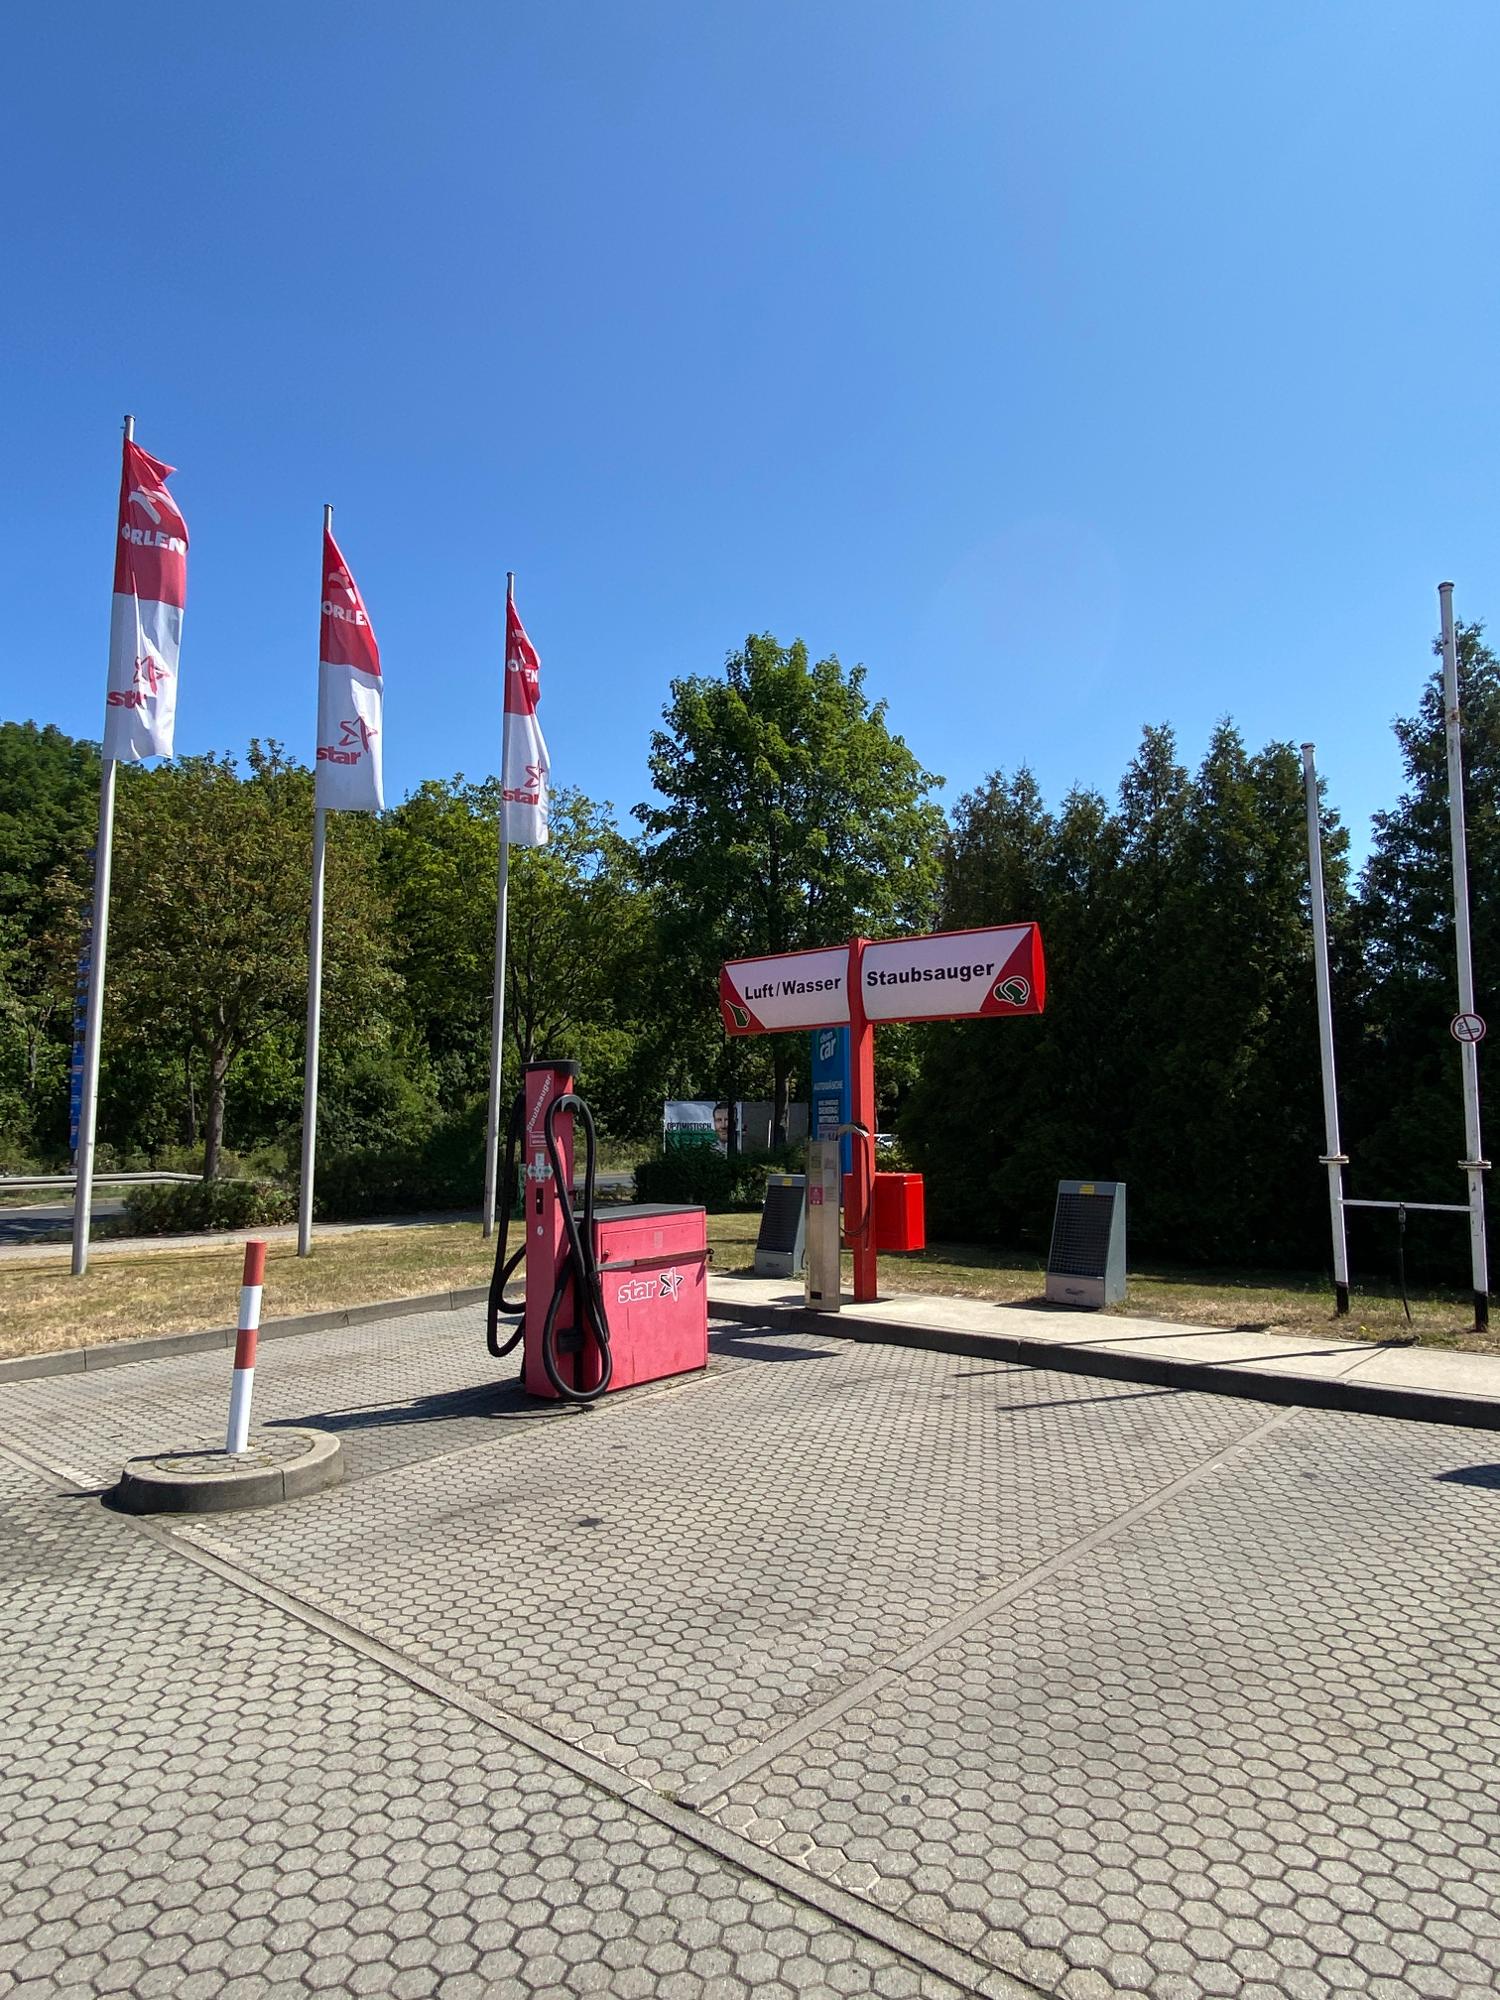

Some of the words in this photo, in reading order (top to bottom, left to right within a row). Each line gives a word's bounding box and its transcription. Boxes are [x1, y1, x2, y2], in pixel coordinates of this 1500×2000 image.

[122, 523, 186, 555] ORLEN
[322, 601, 367, 626] ORLE
[316, 745, 361, 765] star
[866, 962, 994, 988] Staubsauger
[820, 1038, 836, 1061] car
[527, 1074, 552, 1133] Staubsauger
[618, 1280, 657, 1303] star
